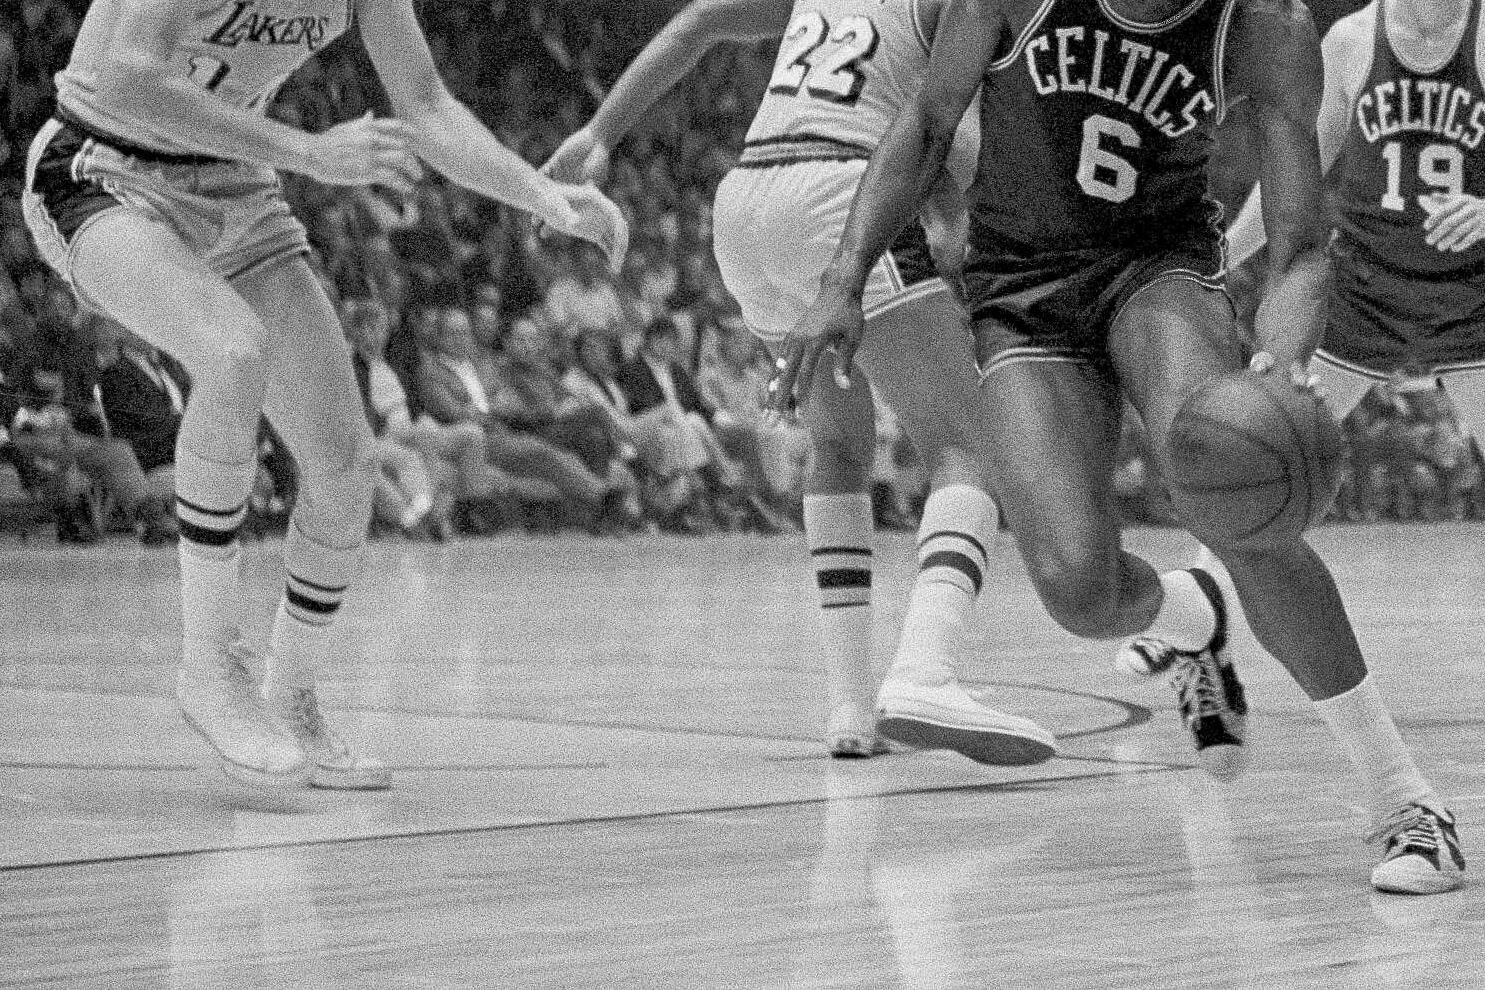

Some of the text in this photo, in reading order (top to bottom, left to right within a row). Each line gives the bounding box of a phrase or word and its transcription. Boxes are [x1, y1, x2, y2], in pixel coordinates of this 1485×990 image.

[202, 0, 329, 51] LAKERS
[768, 11, 880, 108] 22
[1024, 26, 1215, 137] CELTICS
[1076, 114, 1142, 203] 6
[1381, 142, 1465, 211] 19
